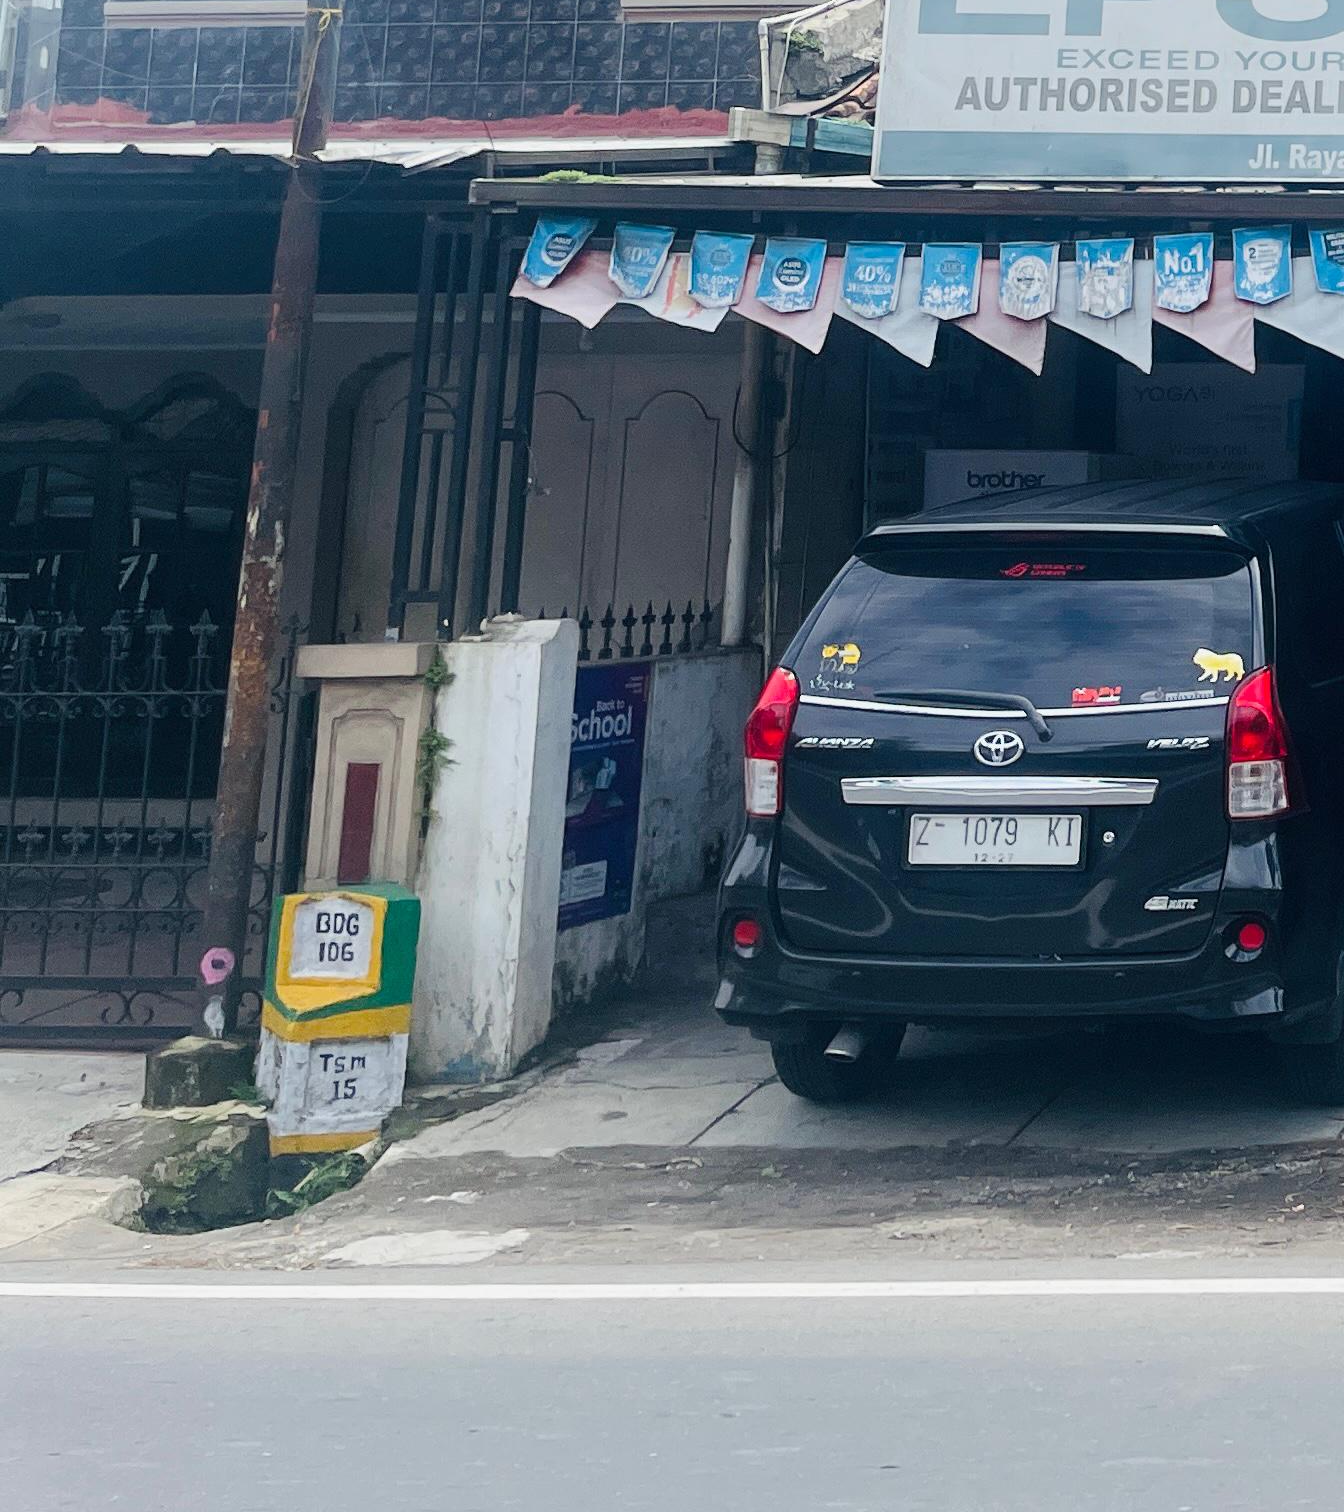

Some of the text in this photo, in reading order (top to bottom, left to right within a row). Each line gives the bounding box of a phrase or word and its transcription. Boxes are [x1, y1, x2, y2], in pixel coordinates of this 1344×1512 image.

[1056, 48, 1222, 73] EXCEED
[955, 76, 1218, 114] AUTHORISED
[1248, 145, 1282, 170] Jl.
[1164, 242, 1204, 274] No.1
[1248, 248, 1256, 258] 2
[854, 265, 891, 283] 40%
[968, 470, 1046, 488] brother
[596, 699, 615, 712] Back
[571, 705, 633, 744] School
[795, 737, 875, 748] AVANZA
[1146, 737, 1210, 750] VELOZ
[915, 816, 1075, 846] Z 1079 KI
[316, 912, 360, 936] BDG
[318, 941, 354, 963] 106
[332, 1078, 357, 1100] 15
